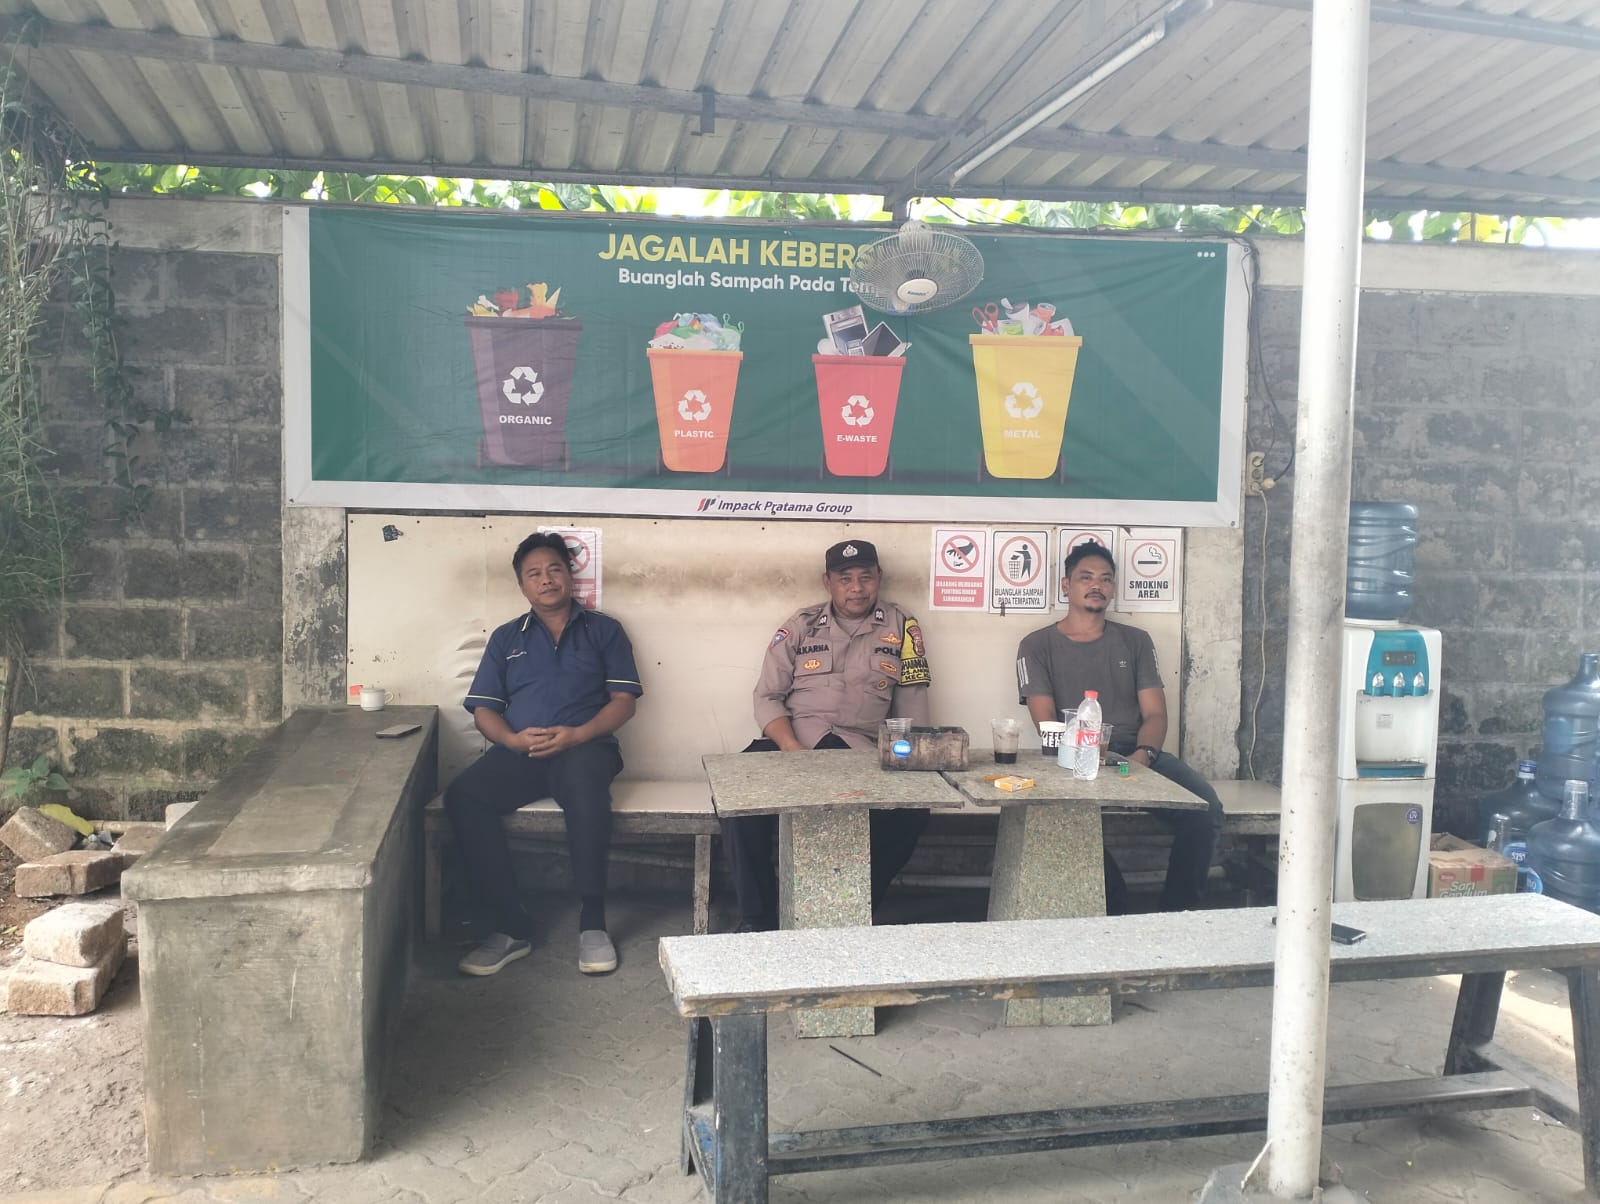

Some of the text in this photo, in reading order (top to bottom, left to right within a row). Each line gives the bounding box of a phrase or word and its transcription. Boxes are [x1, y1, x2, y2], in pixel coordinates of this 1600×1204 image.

[599, 233, 749, 265] JAGALAH
[618, 268, 705, 289] Buanglah
[710, 272, 784, 292] Sampah
[789, 275, 835, 292] Pada
[499, 415, 552, 425] ORGANIC
[674, 430, 714, 438] PLASTIC
[836, 434, 878, 443] E-WASTE
[1004, 430, 1040, 439] METAL
[718, 499, 853, 515] Impack Pratama Group
[1129, 581, 1169, 589] SMOKING
[995, 588, 1044, 597] BUANGLAH SAMPAH
[1137, 590, 1160, 599] AREA
[998, 597, 1040, 606] PADA TEMPATNYA
[1449, 880, 1475, 892] Sari
